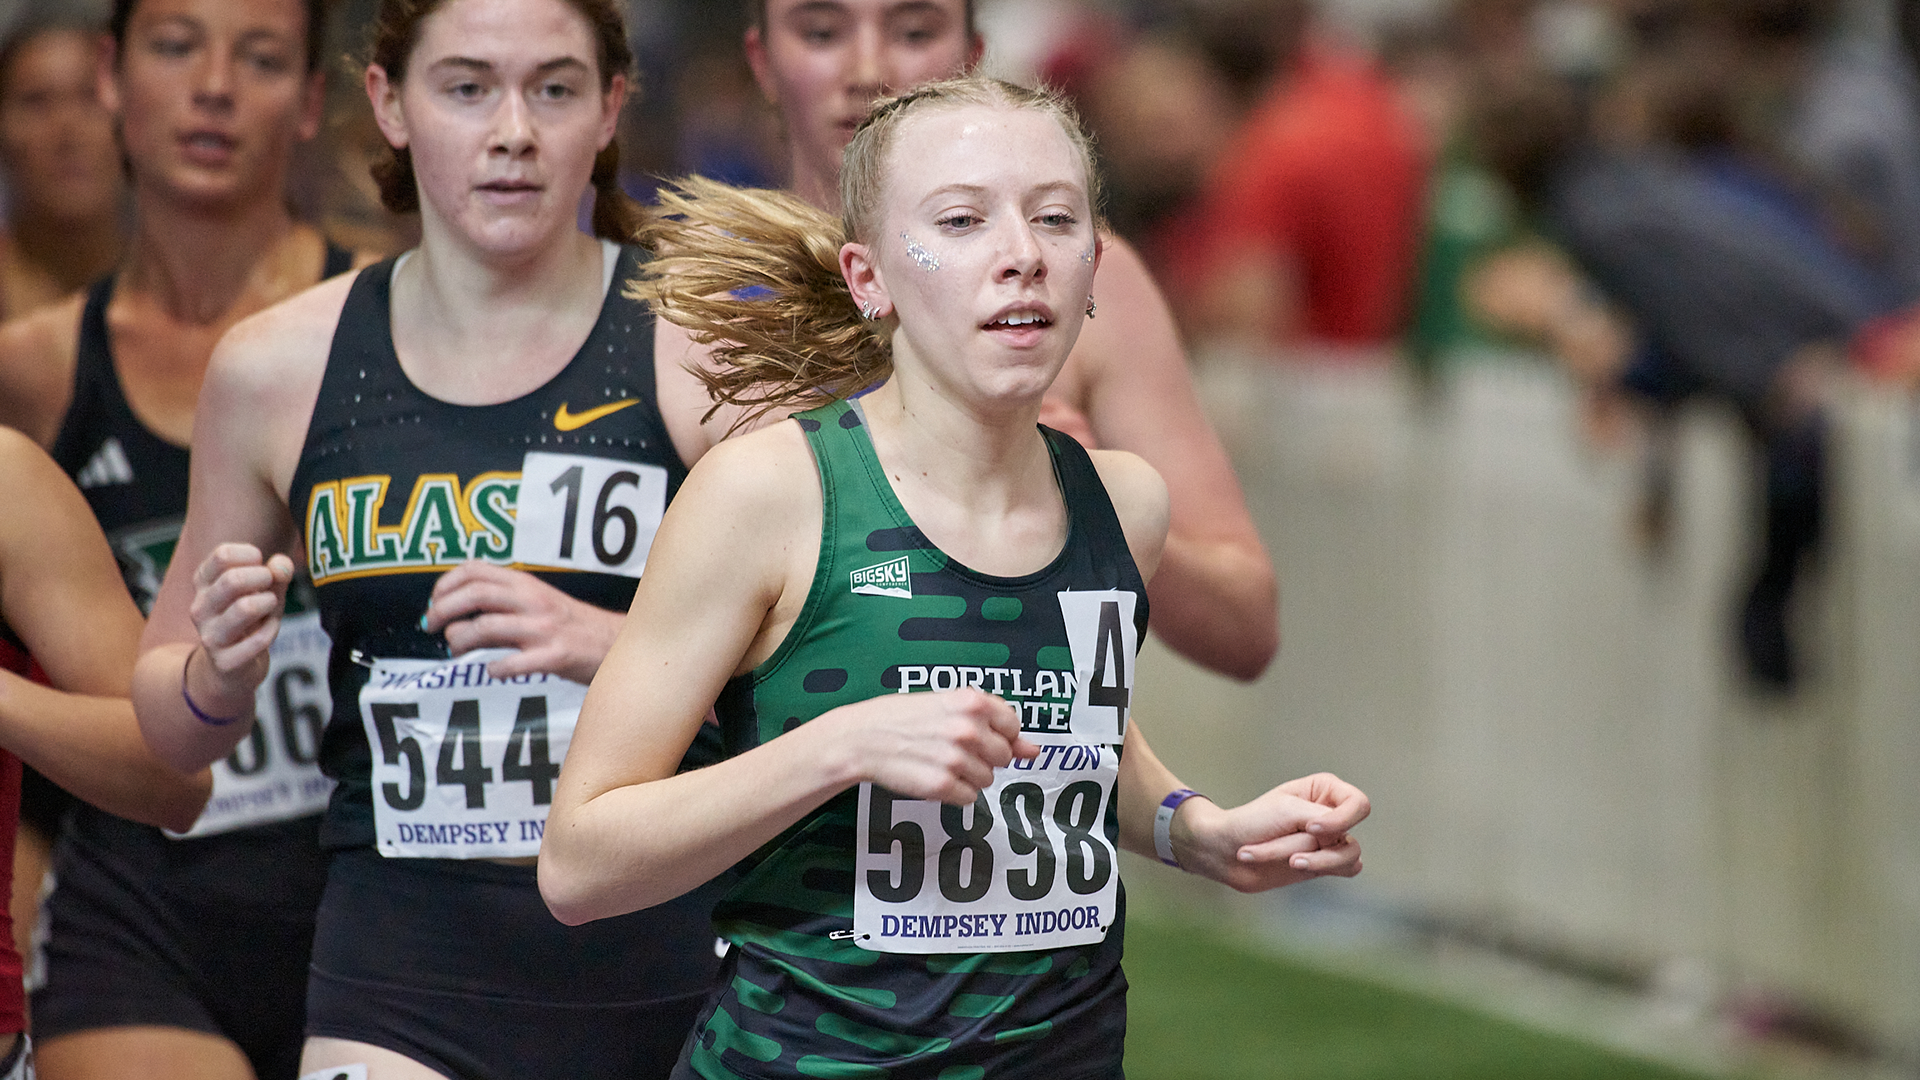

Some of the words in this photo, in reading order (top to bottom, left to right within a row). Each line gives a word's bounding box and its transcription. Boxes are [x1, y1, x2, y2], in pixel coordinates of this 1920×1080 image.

[549, 465, 641, 567] 16
[1088, 601, 1129, 736] 4
[371, 696, 561, 812] 544
[398, 823, 509, 846] DEMPSEY
[866, 779, 1112, 903] 5898
[881, 914, 1007, 938] DEMPSEY
[1015, 905, 1100, 935] INDOOR
